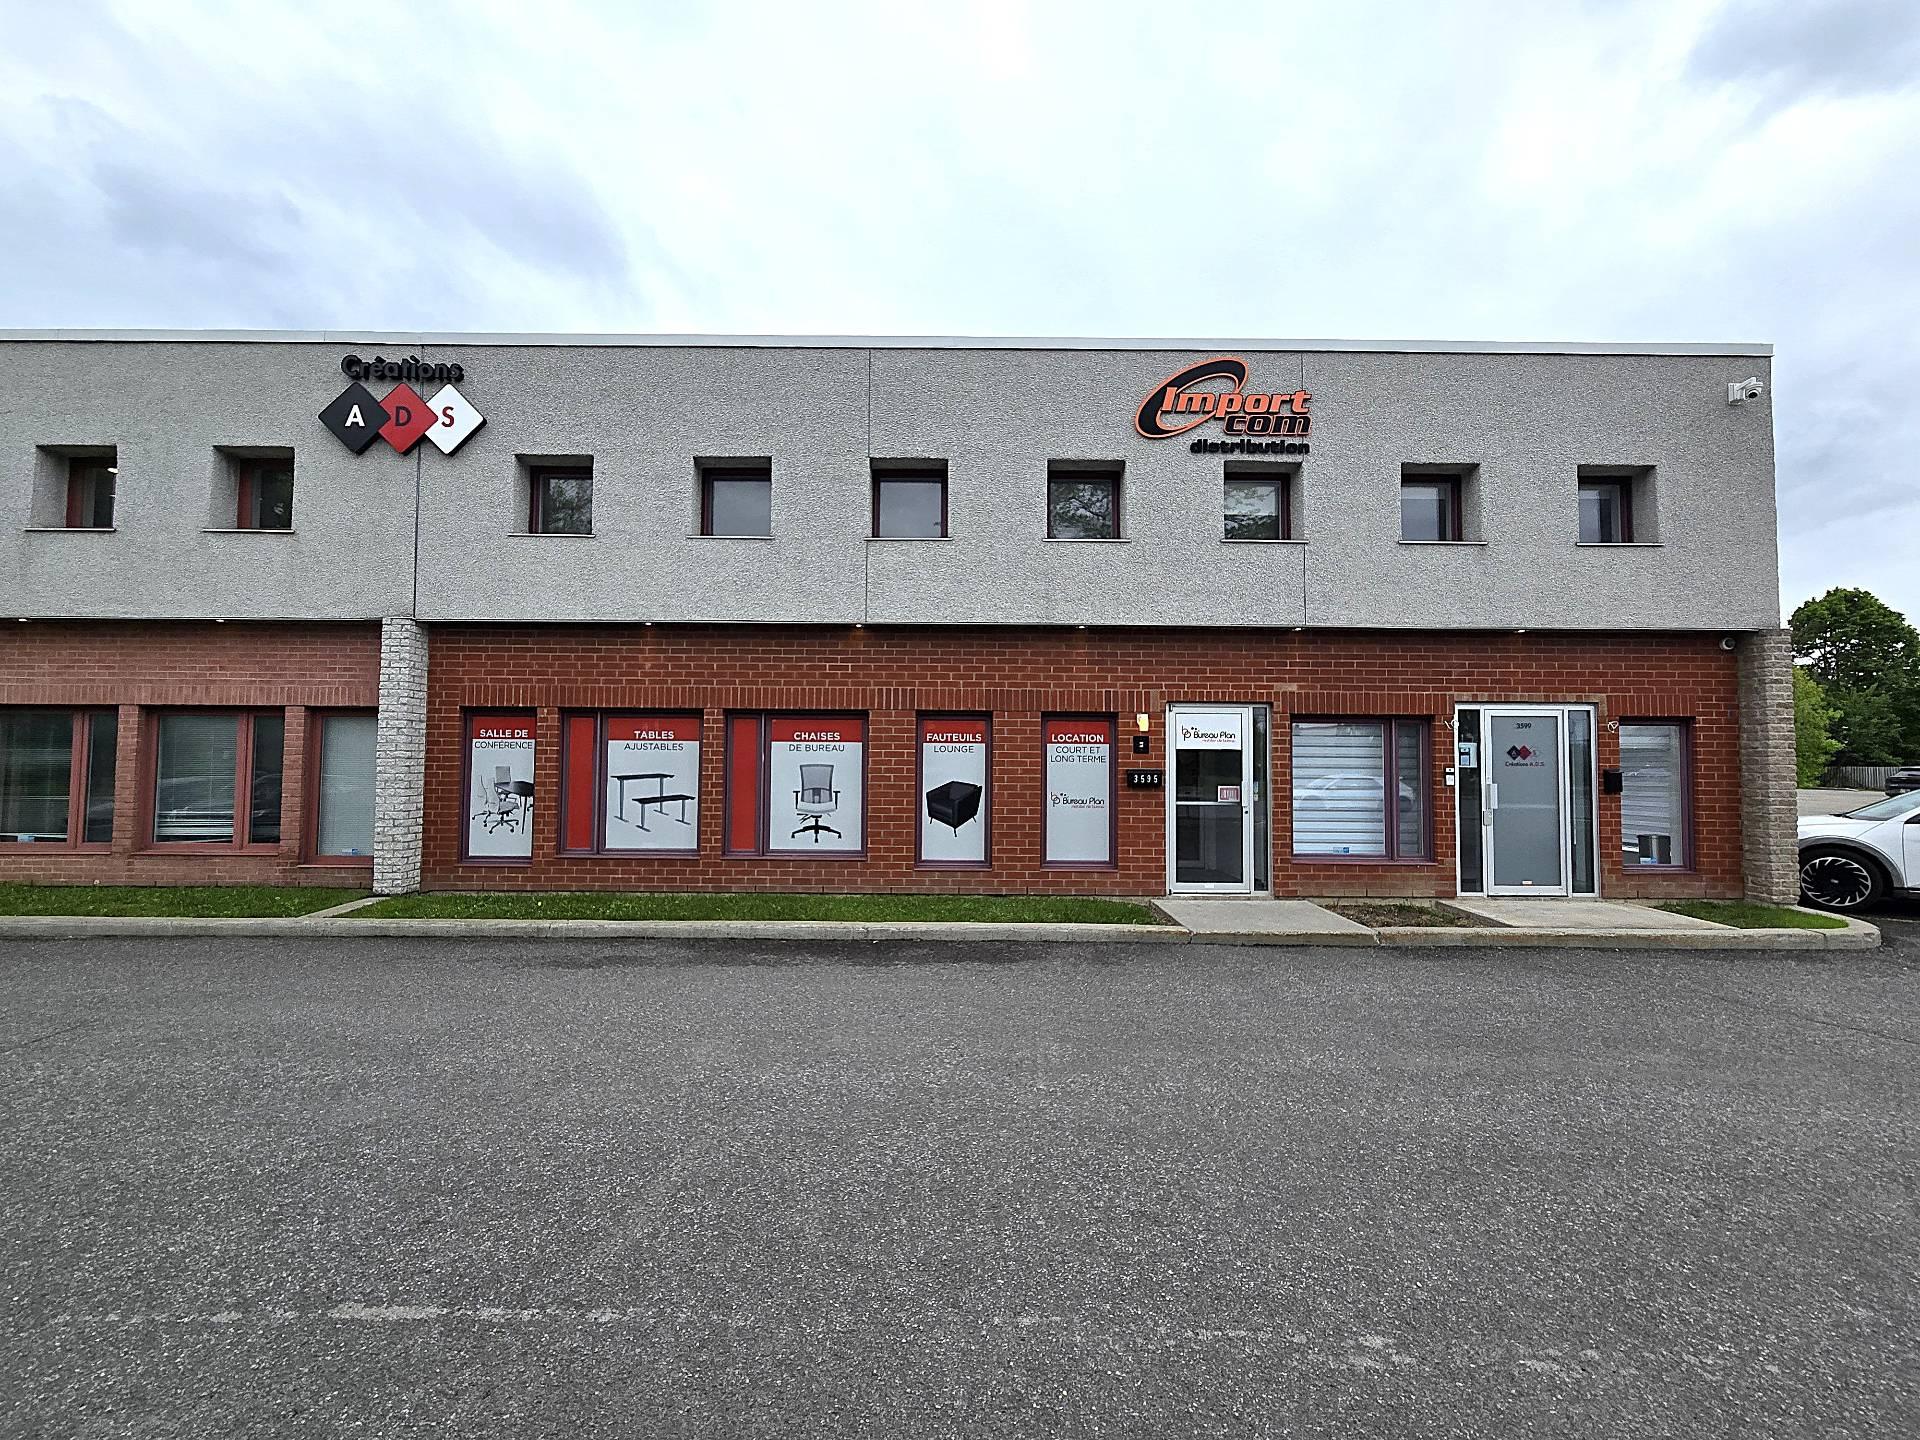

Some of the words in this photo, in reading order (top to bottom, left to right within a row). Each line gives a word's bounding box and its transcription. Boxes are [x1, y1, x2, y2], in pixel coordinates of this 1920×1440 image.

[341, 354, 464, 382] Créations
[1161, 386, 1312, 419] Import
[1223, 414, 1312, 436] com
[1189, 438, 1311, 455] distribution
[480, 729, 512, 738] SALLE
[514, 729, 529, 738] DE
[633, 730, 675, 740] TABLES
[793, 731, 841, 741] CHAISES
[926, 733, 982, 742] FAUTEUILS
[1051, 733, 1104, 743] LOCATION
[1193, 730, 1219, 739] Bureau
[1219, 730, 1236, 739] Plan
[623, 742, 684, 751] AJUSTABLES
[788, 743, 802, 752] DE
[804, 743, 845, 752] BUREAU
[933, 745, 975, 753] LOUNGE
[1055, 745, 1087, 754] COURT
[1089, 746, 1101, 754] ET
[1050, 754, 1075, 763] LONG
[1077, 755, 1107, 763] TERME
[1133, 774, 1158, 784] 3595
[1062, 796, 1088, 805] Bureau
[1088, 796, 1105, 805] Plan
